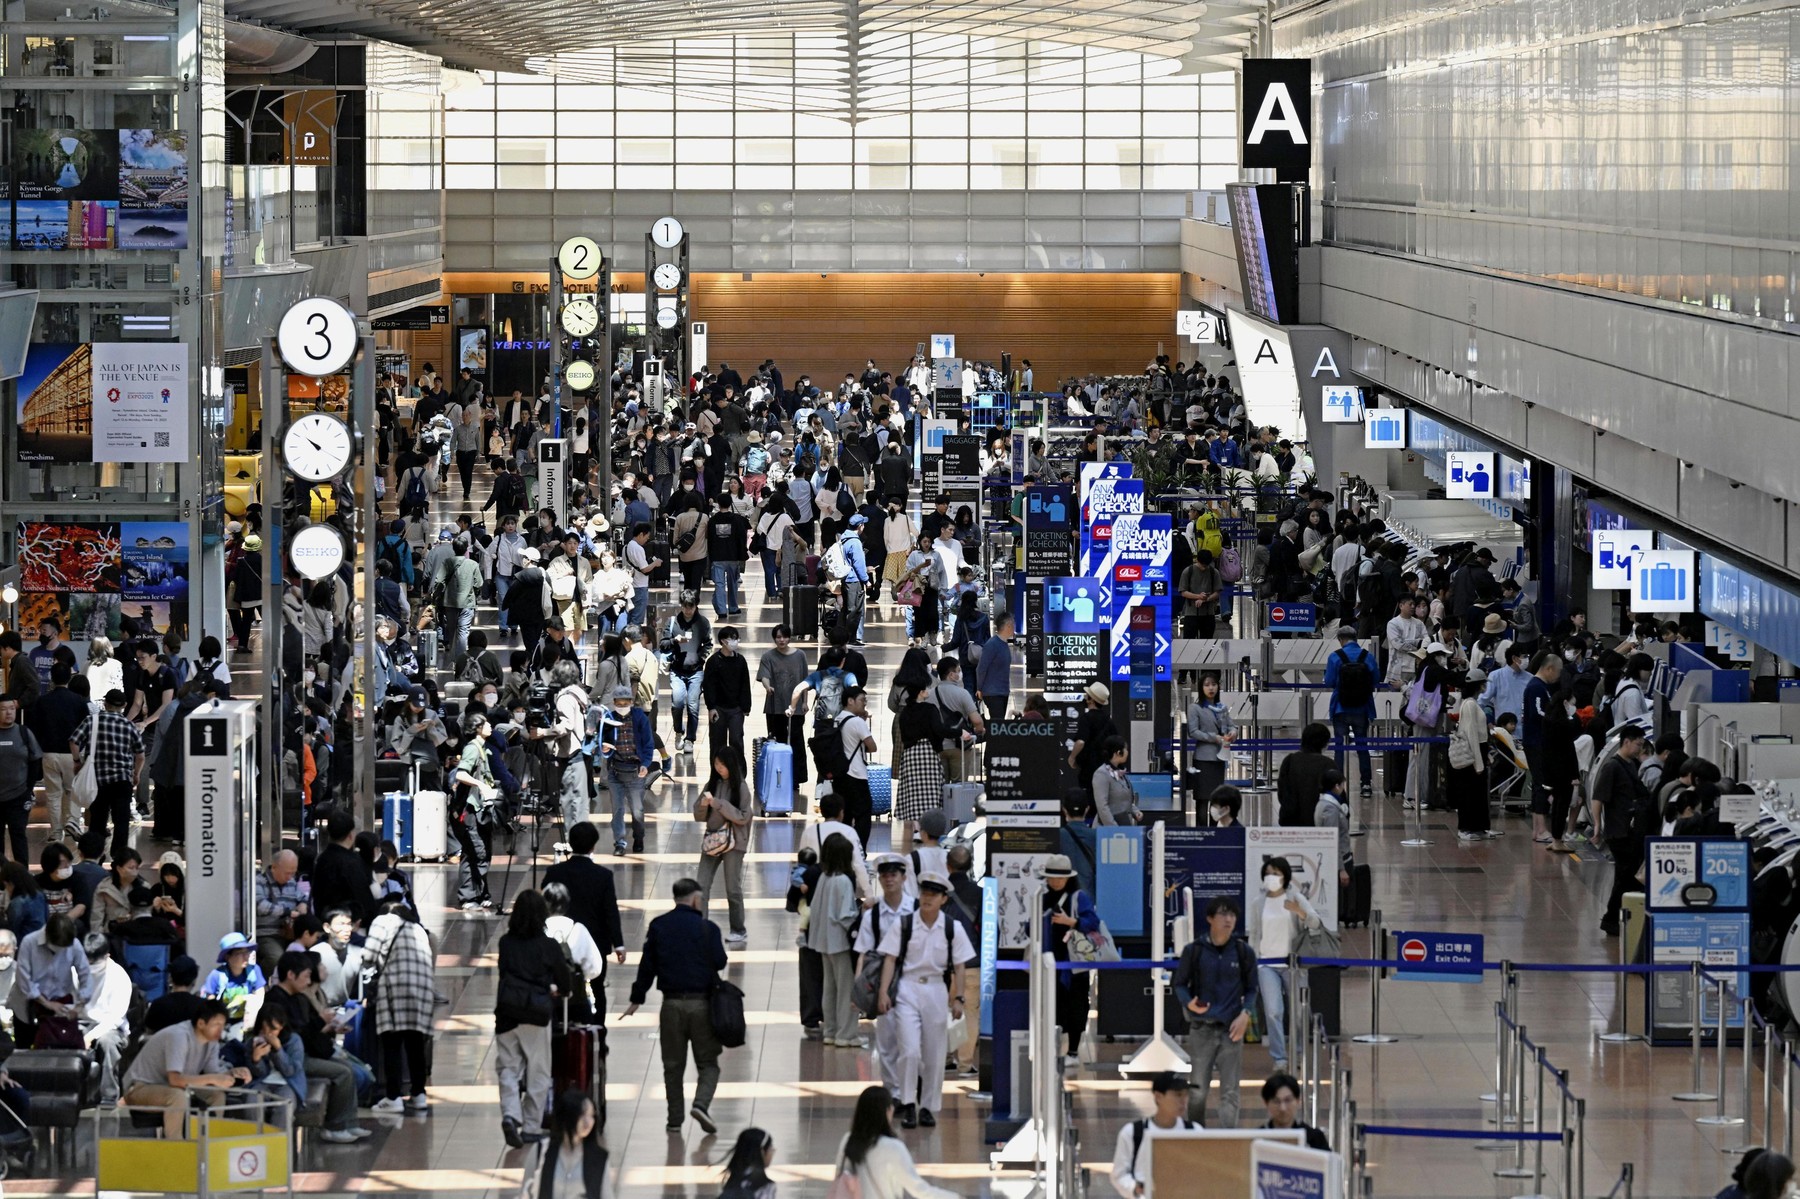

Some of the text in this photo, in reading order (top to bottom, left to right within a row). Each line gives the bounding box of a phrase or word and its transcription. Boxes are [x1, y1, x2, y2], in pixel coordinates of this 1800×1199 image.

[1247, 82, 1308, 144] A
[664, 223, 669, 242] 1
[573, 245, 588, 270] 2
[563, 284, 594, 292] HOTEL
[1197, 322, 1209, 339] 2
[304, 313, 332, 361] 3
[1254, 339, 1278, 364] A
[1311, 347, 1341, 378] A
[138, 364, 168, 373] JAPAN
[1094, 485, 1115, 494] ANA
[1093, 493, 1138, 502] PREMIUM
[1093, 503, 1140, 512] CHECK-IN
[1116, 520, 1140, 530] ANA
[1116, 530, 1166, 540] PREMIUM
[1598, 532, 1604, 540] 6
[1116, 540, 1168, 550] CHECK-IN
[295, 548, 339, 556] SEIKO
[1638, 552, 1644, 563] 7
[1047, 636, 1097, 645] TICKETING
[1086, 646, 1097, 656] IN
[1736, 640, 1747, 657] 3
[990, 723, 1055, 736] BAGGAGE
[991, 757, 1020, 767] 手荷物
[991, 770, 1021, 778] Baggage
[202, 768, 218, 877] Information
[1435, 943, 1472, 953] 出口専用
[983, 922, 995, 1001] ENTRANCE
